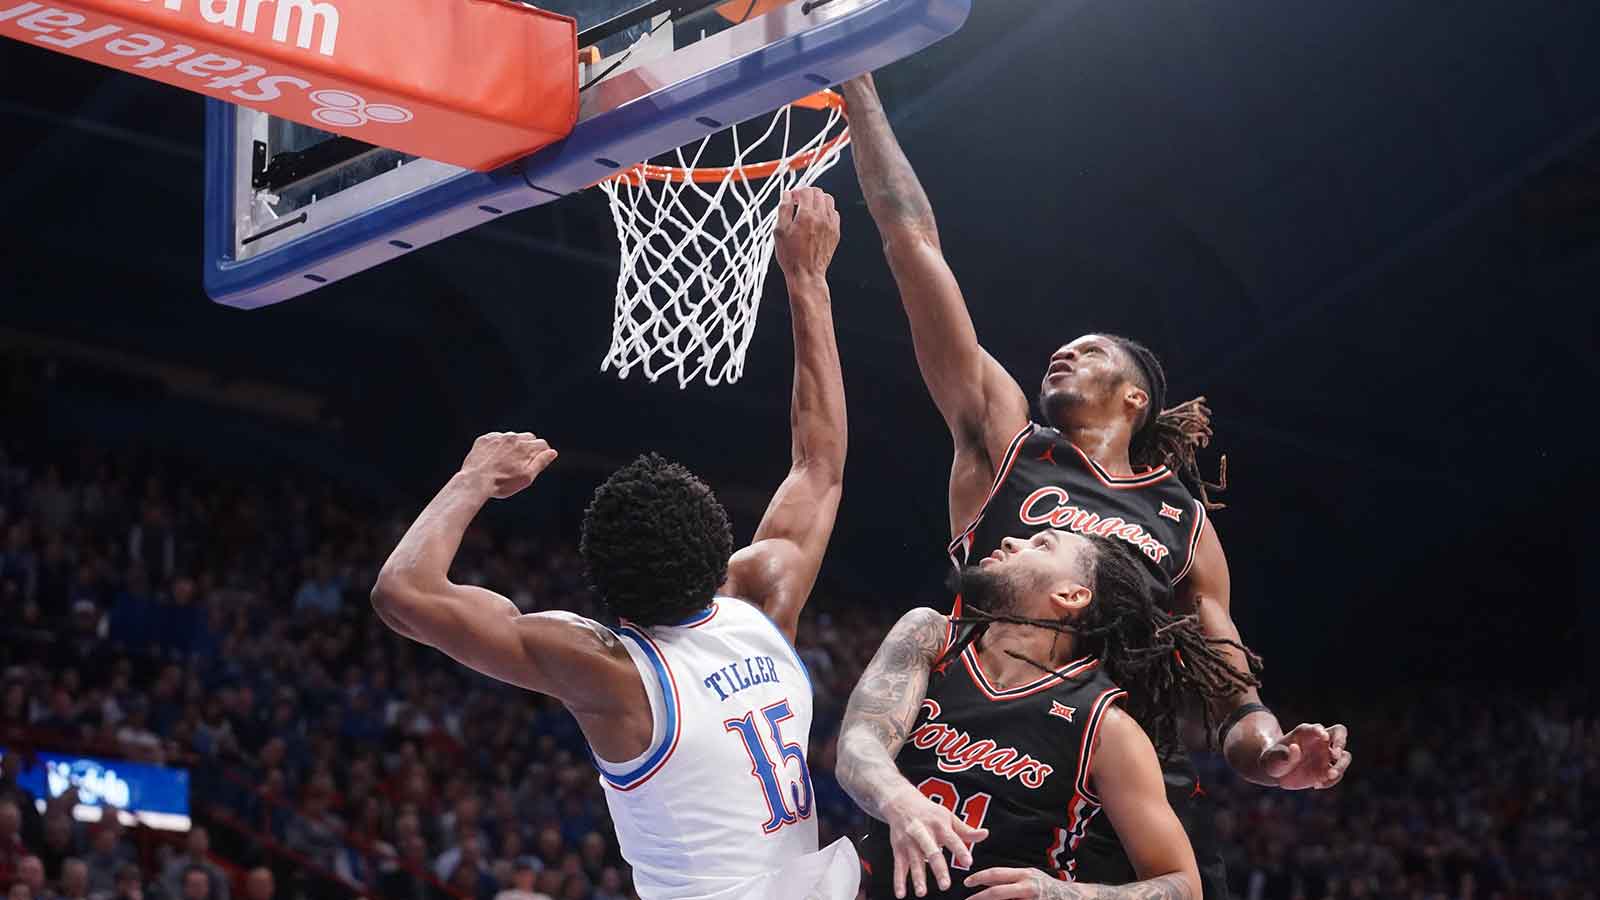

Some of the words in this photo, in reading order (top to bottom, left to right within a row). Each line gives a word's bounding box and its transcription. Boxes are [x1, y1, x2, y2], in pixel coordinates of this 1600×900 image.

[163, 0, 340, 57] arm
[1019, 486, 1169, 564] Cougars
[703, 656, 780, 702] TILLER
[723, 697, 813, 834] 15
